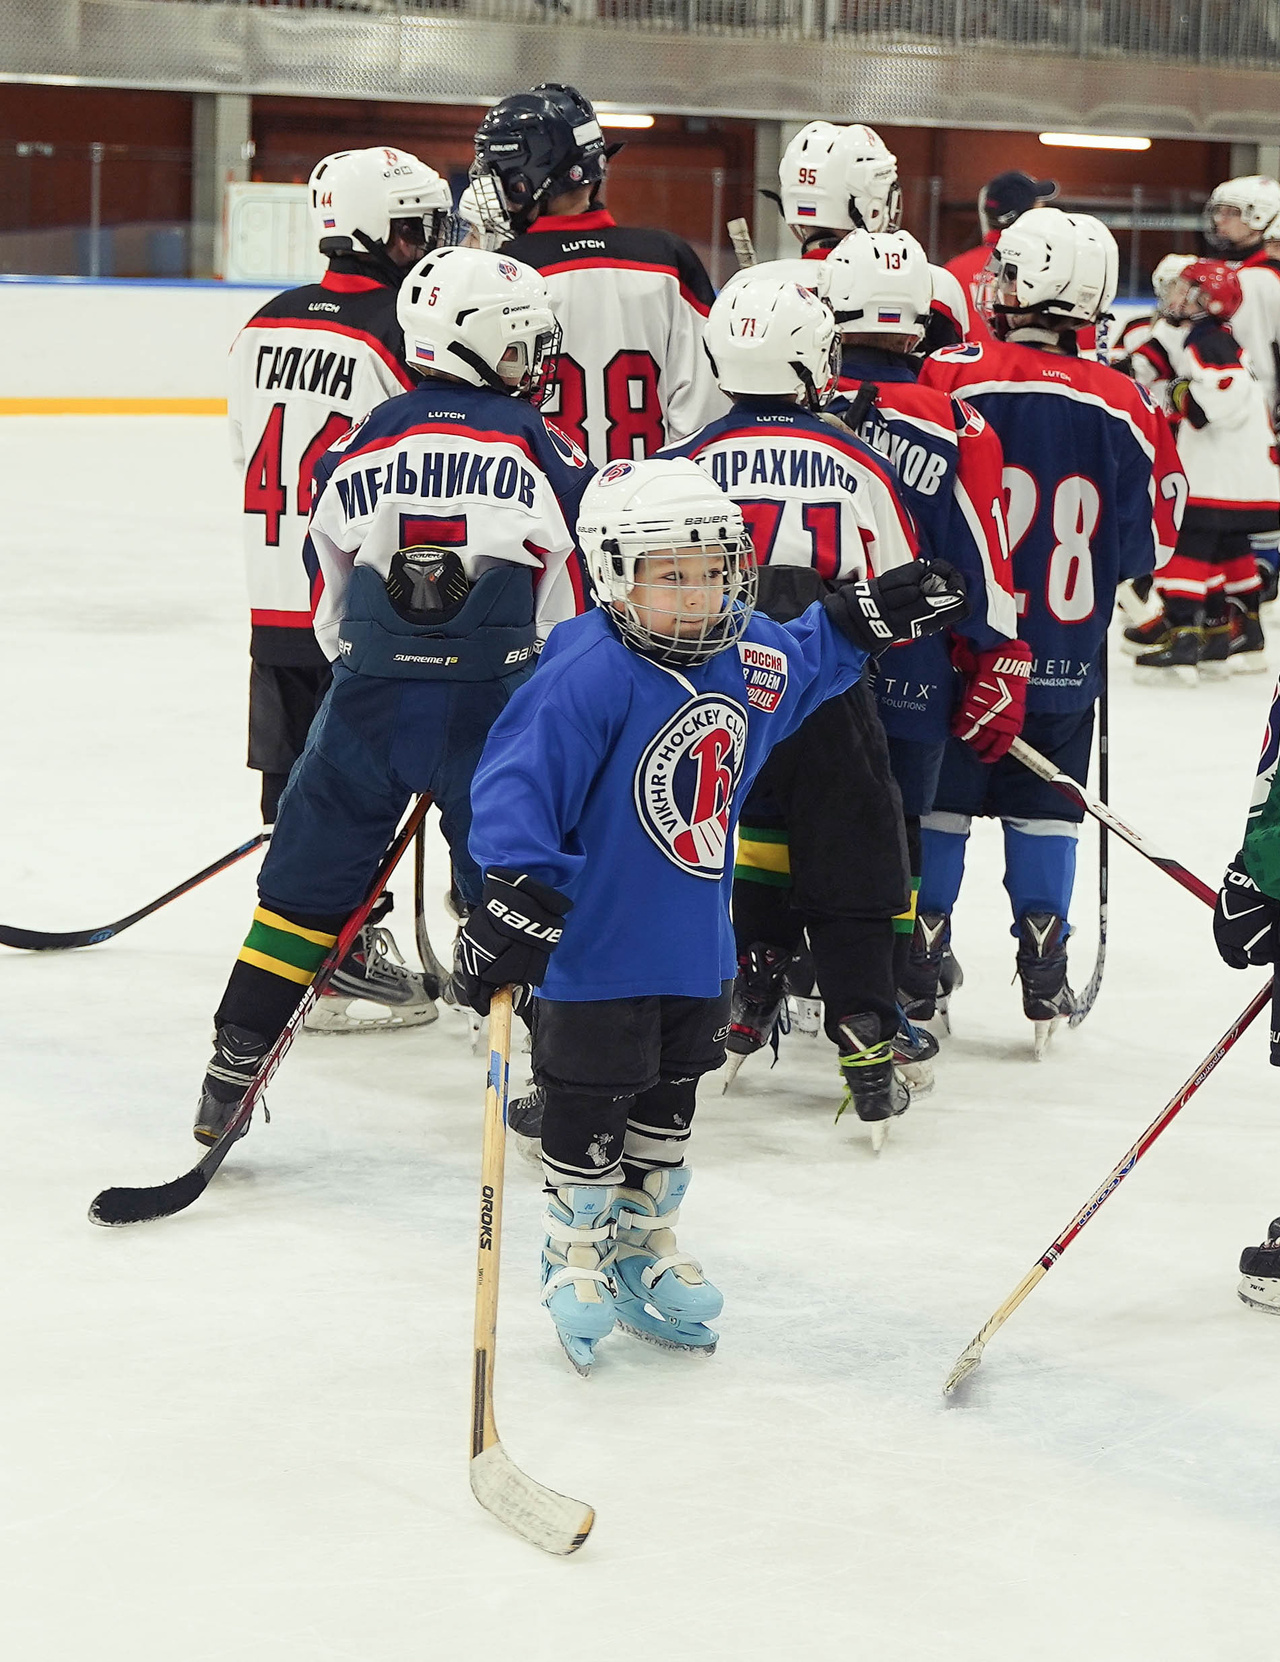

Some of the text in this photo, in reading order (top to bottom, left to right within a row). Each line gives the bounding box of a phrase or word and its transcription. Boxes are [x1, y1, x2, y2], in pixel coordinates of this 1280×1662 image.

[798, 167, 817, 185] 95
[320, 191, 332, 208] 44
[561, 240, 606, 252] LUTCH
[884, 252, 901, 269] 13
[428, 286, 441, 307] 5
[308, 302, 341, 314] LUTCH
[740, 317, 756, 337] 71
[255, 345, 357, 401] ГАЛКИН
[1042, 369, 1072, 382] LUTCH
[428, 411, 466, 420] LUTCH
[756, 415, 794, 423] LUTCH
[855, 419, 948, 497] ЕЙКОВ
[684, 514, 729, 526] BAUER
[393, 654, 444, 664] SUPREME
[744, 648, 783, 671] РОССИЯ
[750, 669, 782, 691] МОЁМ
[659, 709, 721, 762] HOCKEY
[650, 773, 679, 834] VIKHR
[486, 898, 563, 944] BAUE
[480, 1185, 494, 1251] OROKS
